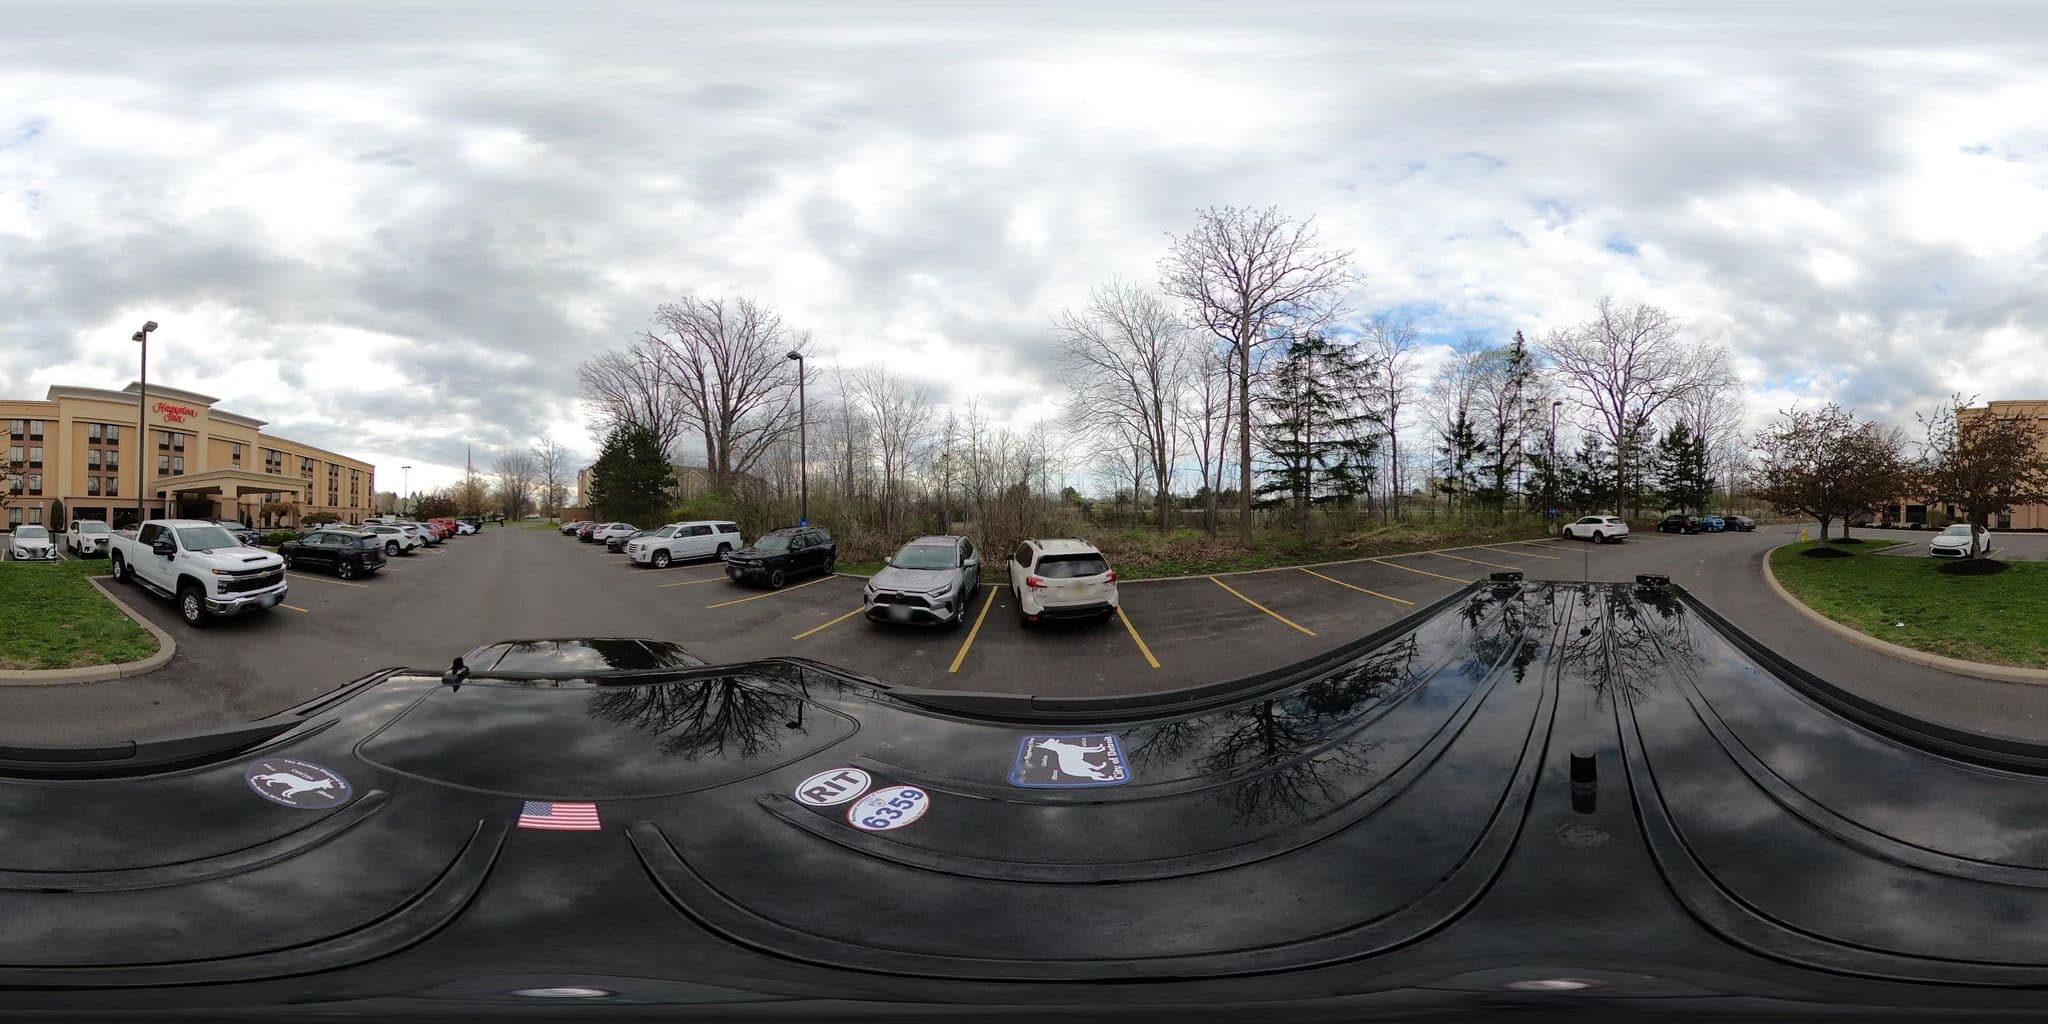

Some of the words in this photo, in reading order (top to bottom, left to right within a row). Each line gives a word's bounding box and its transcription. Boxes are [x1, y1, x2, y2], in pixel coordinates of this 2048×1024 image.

[152, 402, 198, 417] Hampton
[164, 412, 185, 423] Inn
[1104, 735, 1116, 756] Detroit
[1108, 756, 1119, 764] of
[1112, 765, 1125, 780] City
[803, 771, 860, 803] RIT
[862, 789, 924, 829] 6359
